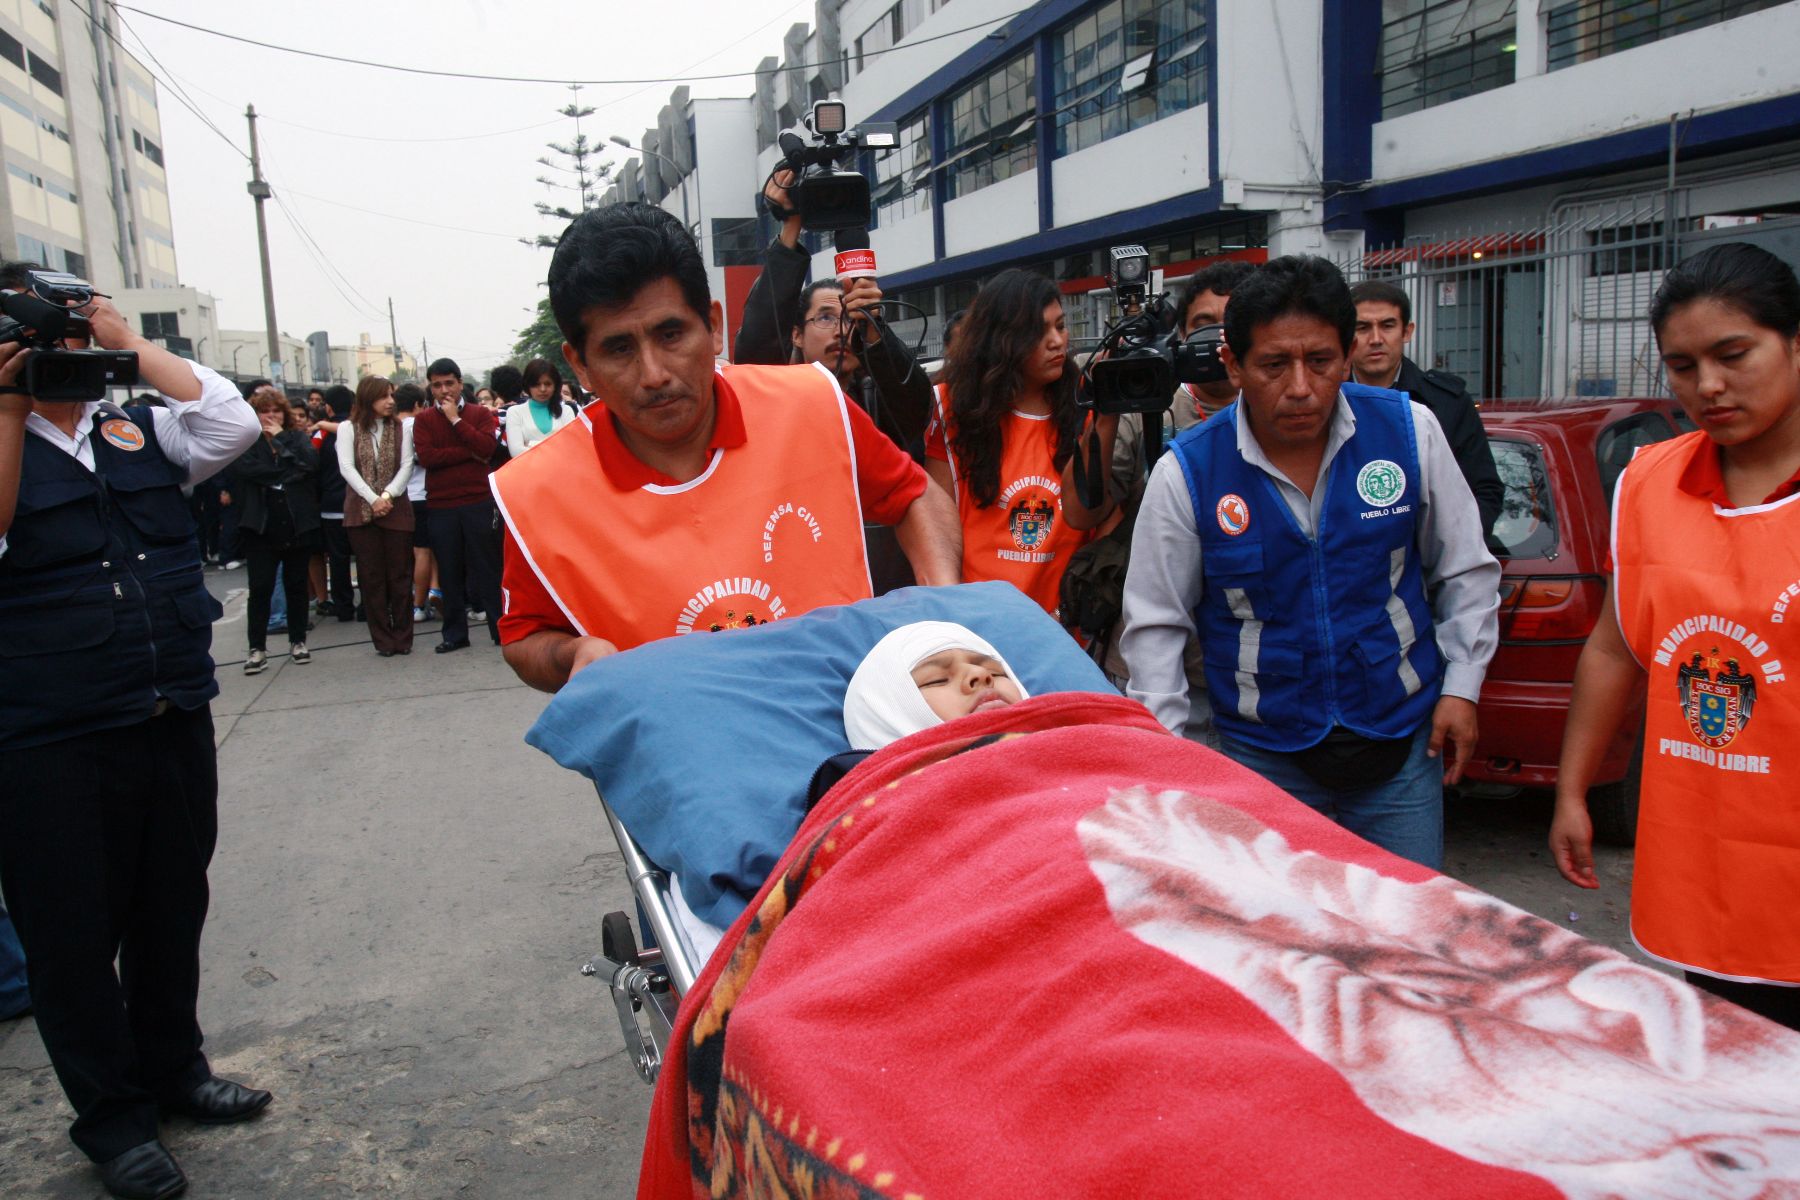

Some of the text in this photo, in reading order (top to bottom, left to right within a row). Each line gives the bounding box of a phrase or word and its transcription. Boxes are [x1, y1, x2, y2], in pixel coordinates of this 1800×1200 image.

[999, 475, 1061, 509] MUNICIPALIDAD
[1360, 505, 1411, 520] PUEBLO LIBRE
[763, 502, 822, 563] DEFENSA CIVIL
[997, 549, 1031, 562] PUEBLO
[675, 577, 787, 634] UNICIPALIDAD DE
[1770, 579, 1800, 624] DEFE
[1654, 615, 1786, 684] MUNICIPALIDAD DE
[1696, 681, 1713, 692] HOC
[1659, 738, 1771, 774] PUEBLO LIBRE
